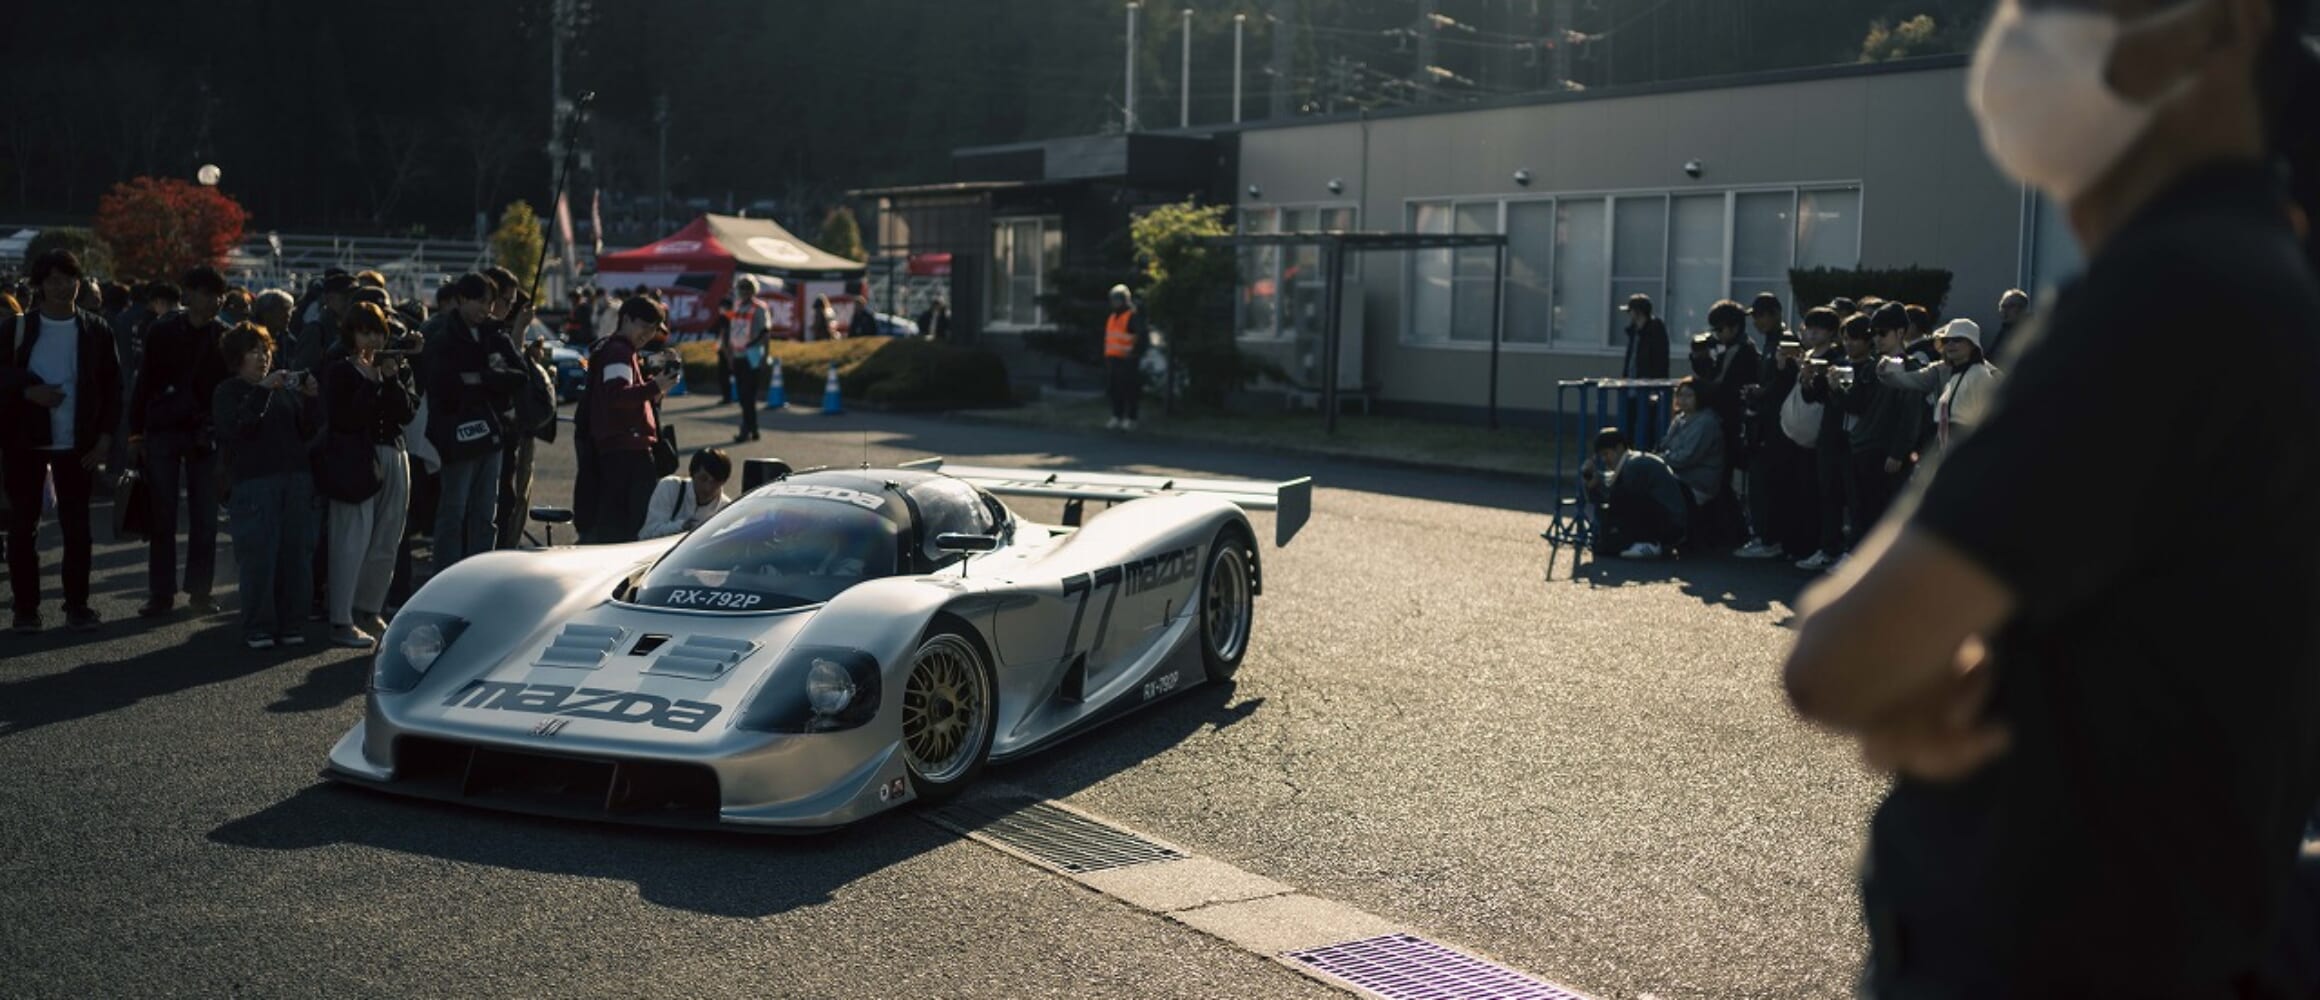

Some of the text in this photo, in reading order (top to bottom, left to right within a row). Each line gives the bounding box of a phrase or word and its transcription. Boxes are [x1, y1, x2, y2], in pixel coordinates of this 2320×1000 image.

[667, 589, 761, 608] RX-792P
[1062, 565, 1122, 661] 77
[442, 680, 722, 733] mazda
